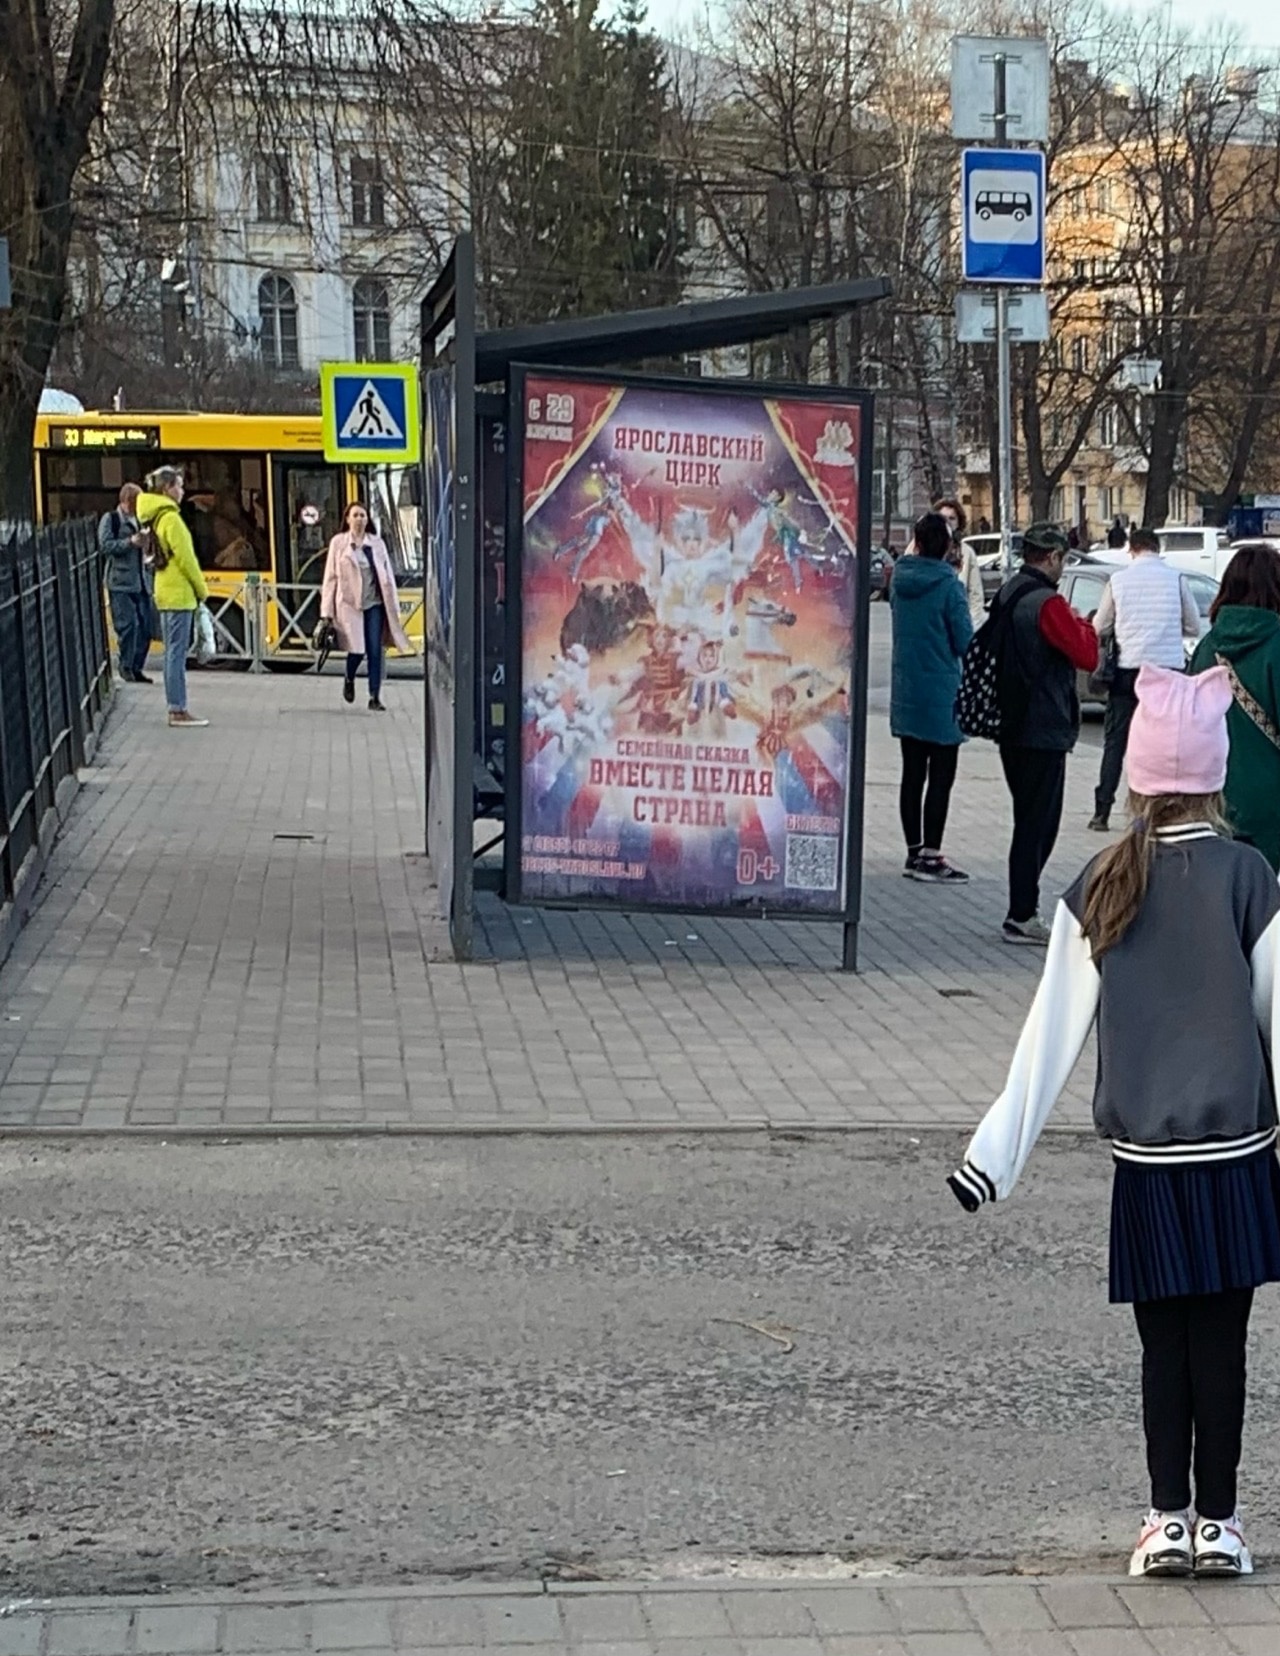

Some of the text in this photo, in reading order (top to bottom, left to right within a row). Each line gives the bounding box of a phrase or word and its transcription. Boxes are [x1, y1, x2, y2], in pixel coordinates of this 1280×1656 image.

[546, 393, 575, 423] 29
[613, 427, 765, 463] ЯРОСЛАВСКИЙ
[664, 459, 722, 488] ЦИРК
[616, 739, 751, 764] СЕМЕЙНАЯ СКАЗКА
[589, 758, 774, 799] ВМЕСТЕ ЦЕЛАЯ
[633, 795, 728, 827] СТРАНА
[736, 848, 781, 886] 0+
